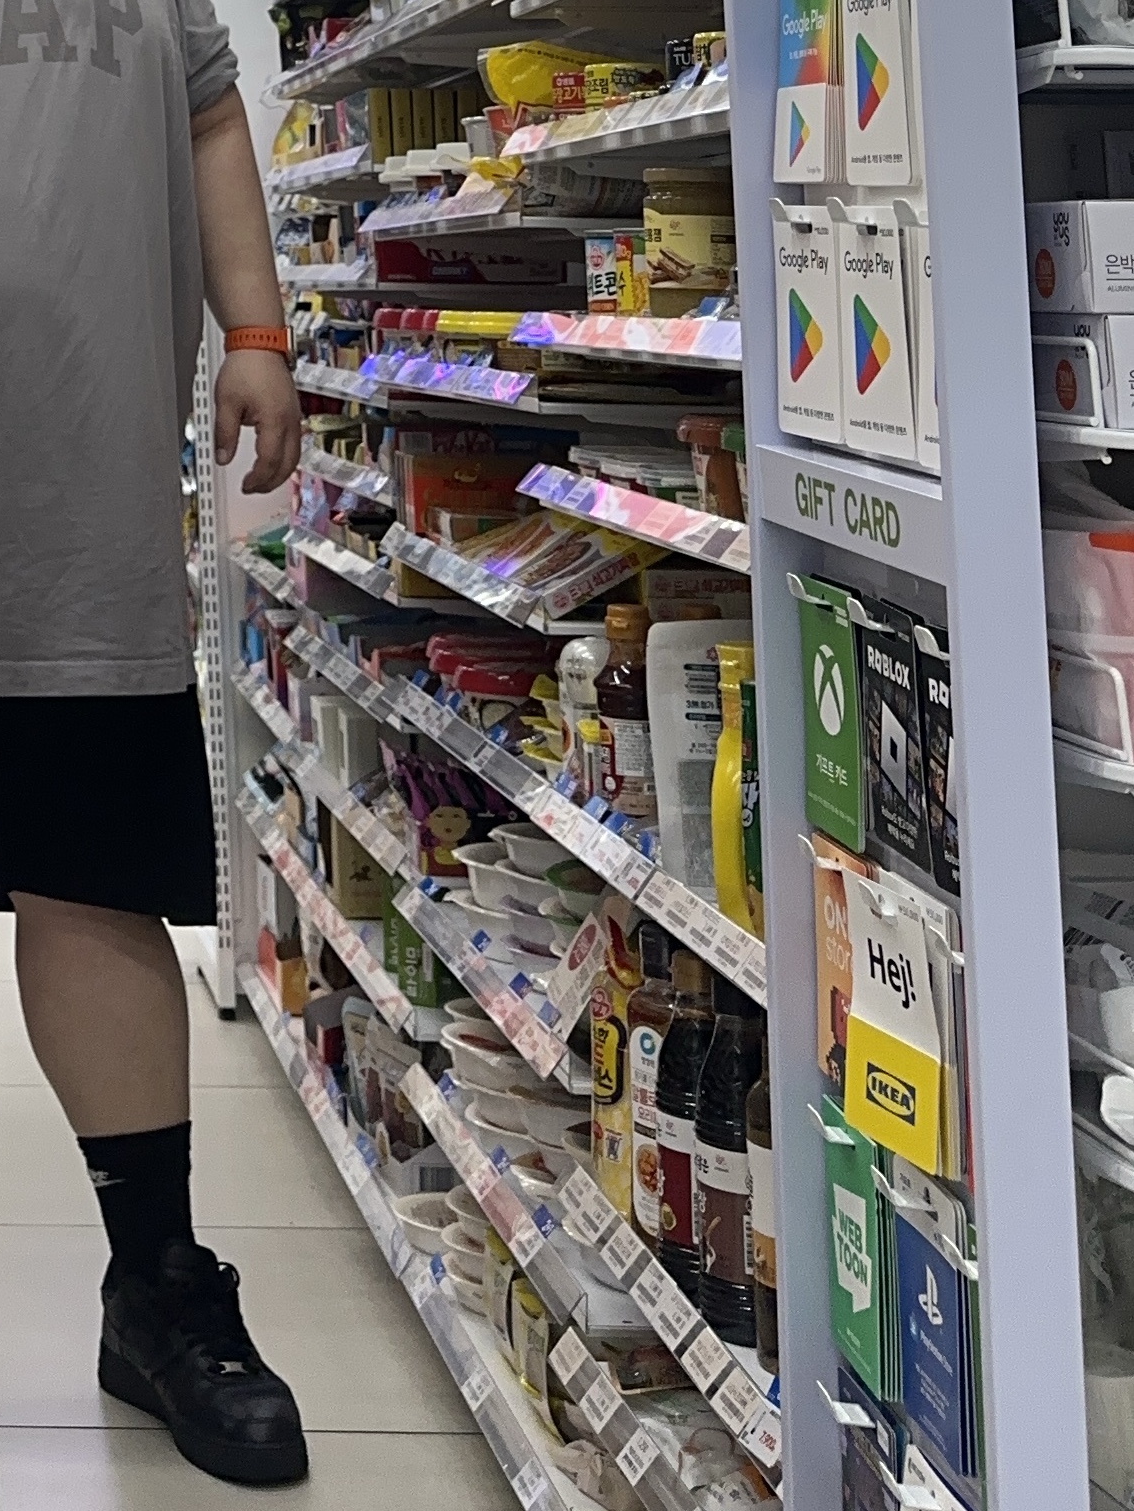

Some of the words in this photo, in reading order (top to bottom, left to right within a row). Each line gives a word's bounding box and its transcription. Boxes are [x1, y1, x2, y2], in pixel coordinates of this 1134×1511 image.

[782, 12, 811, 39] Google
[810, 8, 827, 33] Play
[778, 246, 809, 275] Google
[809, 248, 829, 276] Play
[844, 251, 874, 279] Google
[874, 252, 894, 280] Play
[794, 471, 836, 527] GIFT
[843, 487, 902, 550] CARD
[866, 644, 911, 691] ROBLOX
[928, 676, 950, 710] RO
[824, 935, 852, 974] stor
[867, 937, 917, 1010] Hej!
[871, 1074, 912, 1112] IKEA
[838, 1205, 863, 1248] WEB
[836, 1236, 868, 1287] TOON
